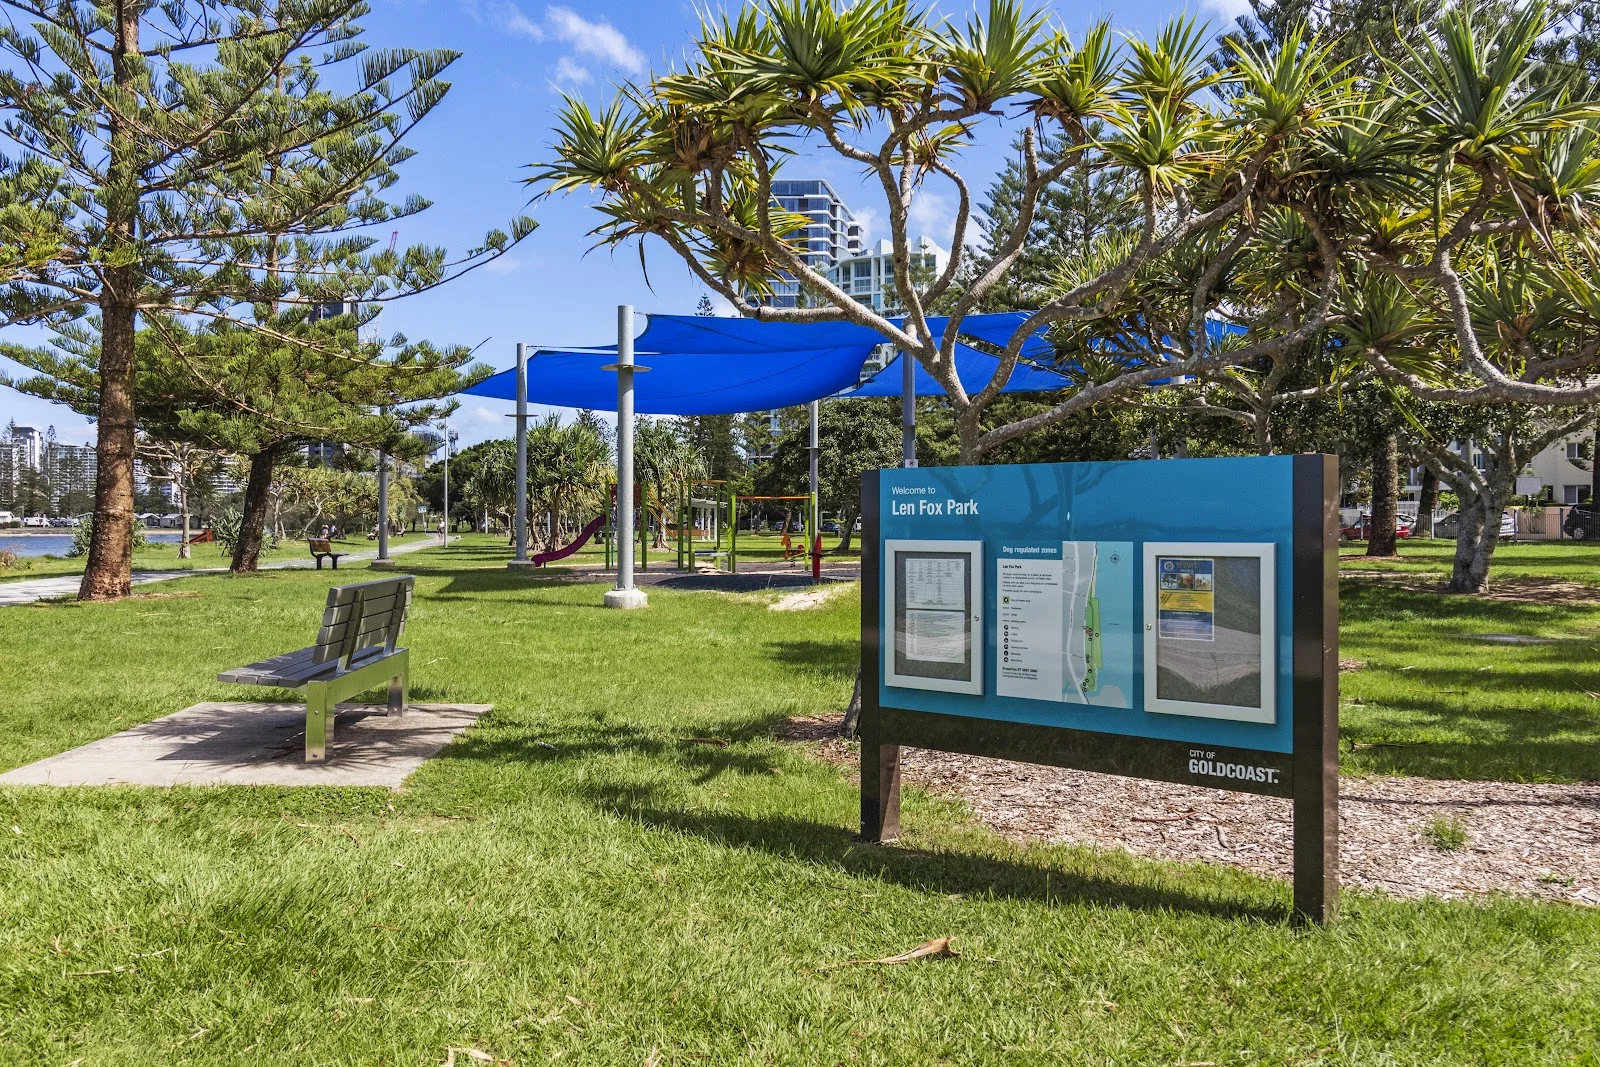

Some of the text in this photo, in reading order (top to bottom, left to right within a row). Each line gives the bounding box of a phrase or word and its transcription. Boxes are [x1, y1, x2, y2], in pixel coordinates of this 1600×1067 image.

[891, 486, 936, 495] Welcome to
[891, 498, 979, 516] Len Fox Park
[1002, 546, 1013, 554] Dog
[1014, 546, 1040, 555] regulated
[1189, 749, 1216, 760] CITY OF
